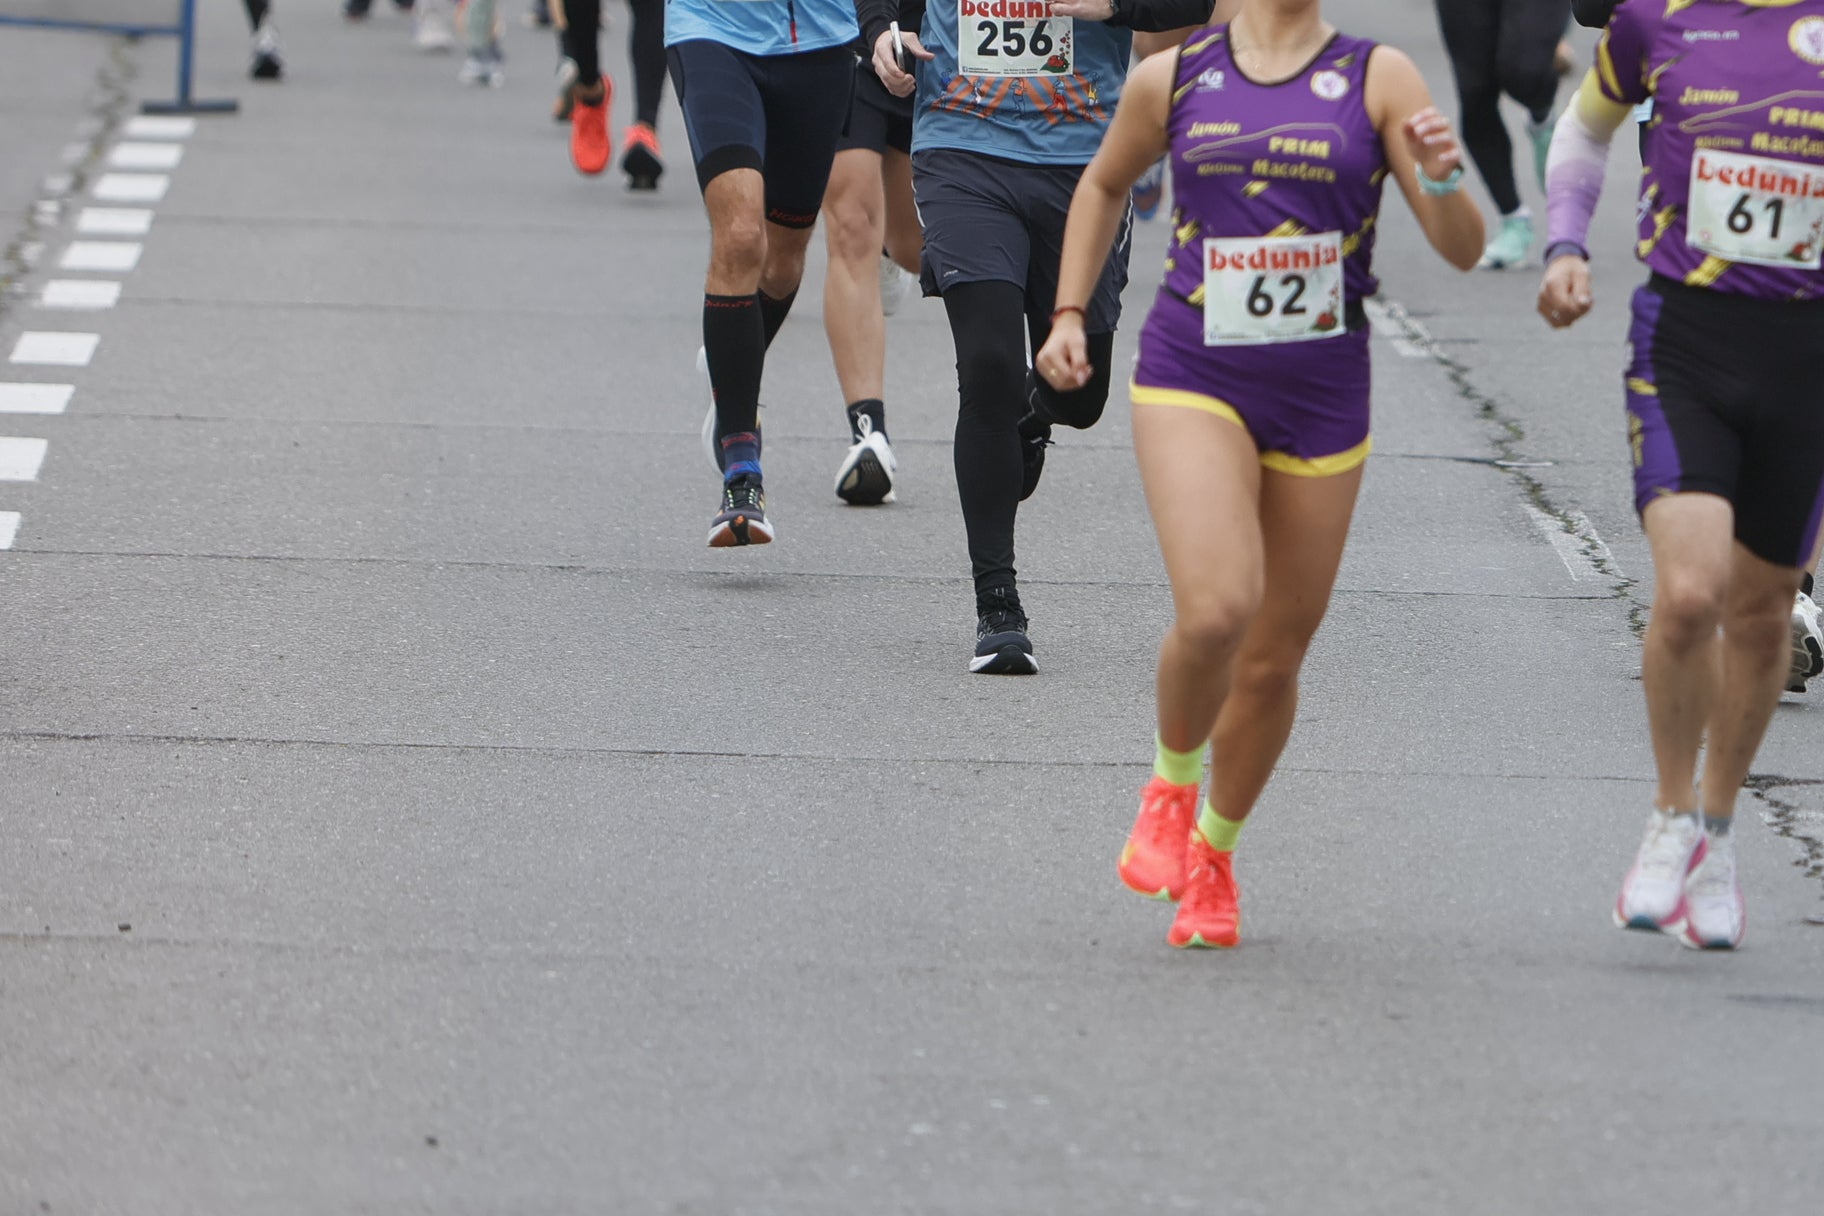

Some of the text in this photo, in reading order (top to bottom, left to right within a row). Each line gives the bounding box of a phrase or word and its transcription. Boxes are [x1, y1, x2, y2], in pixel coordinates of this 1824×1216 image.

[977, 20, 1053, 57] 256
[1186, 119, 1241, 139] Jamón
[1727, 191, 1784, 240] 61
[1209, 242, 1338, 272] bedunia
[1247, 273, 1307, 318] 62
